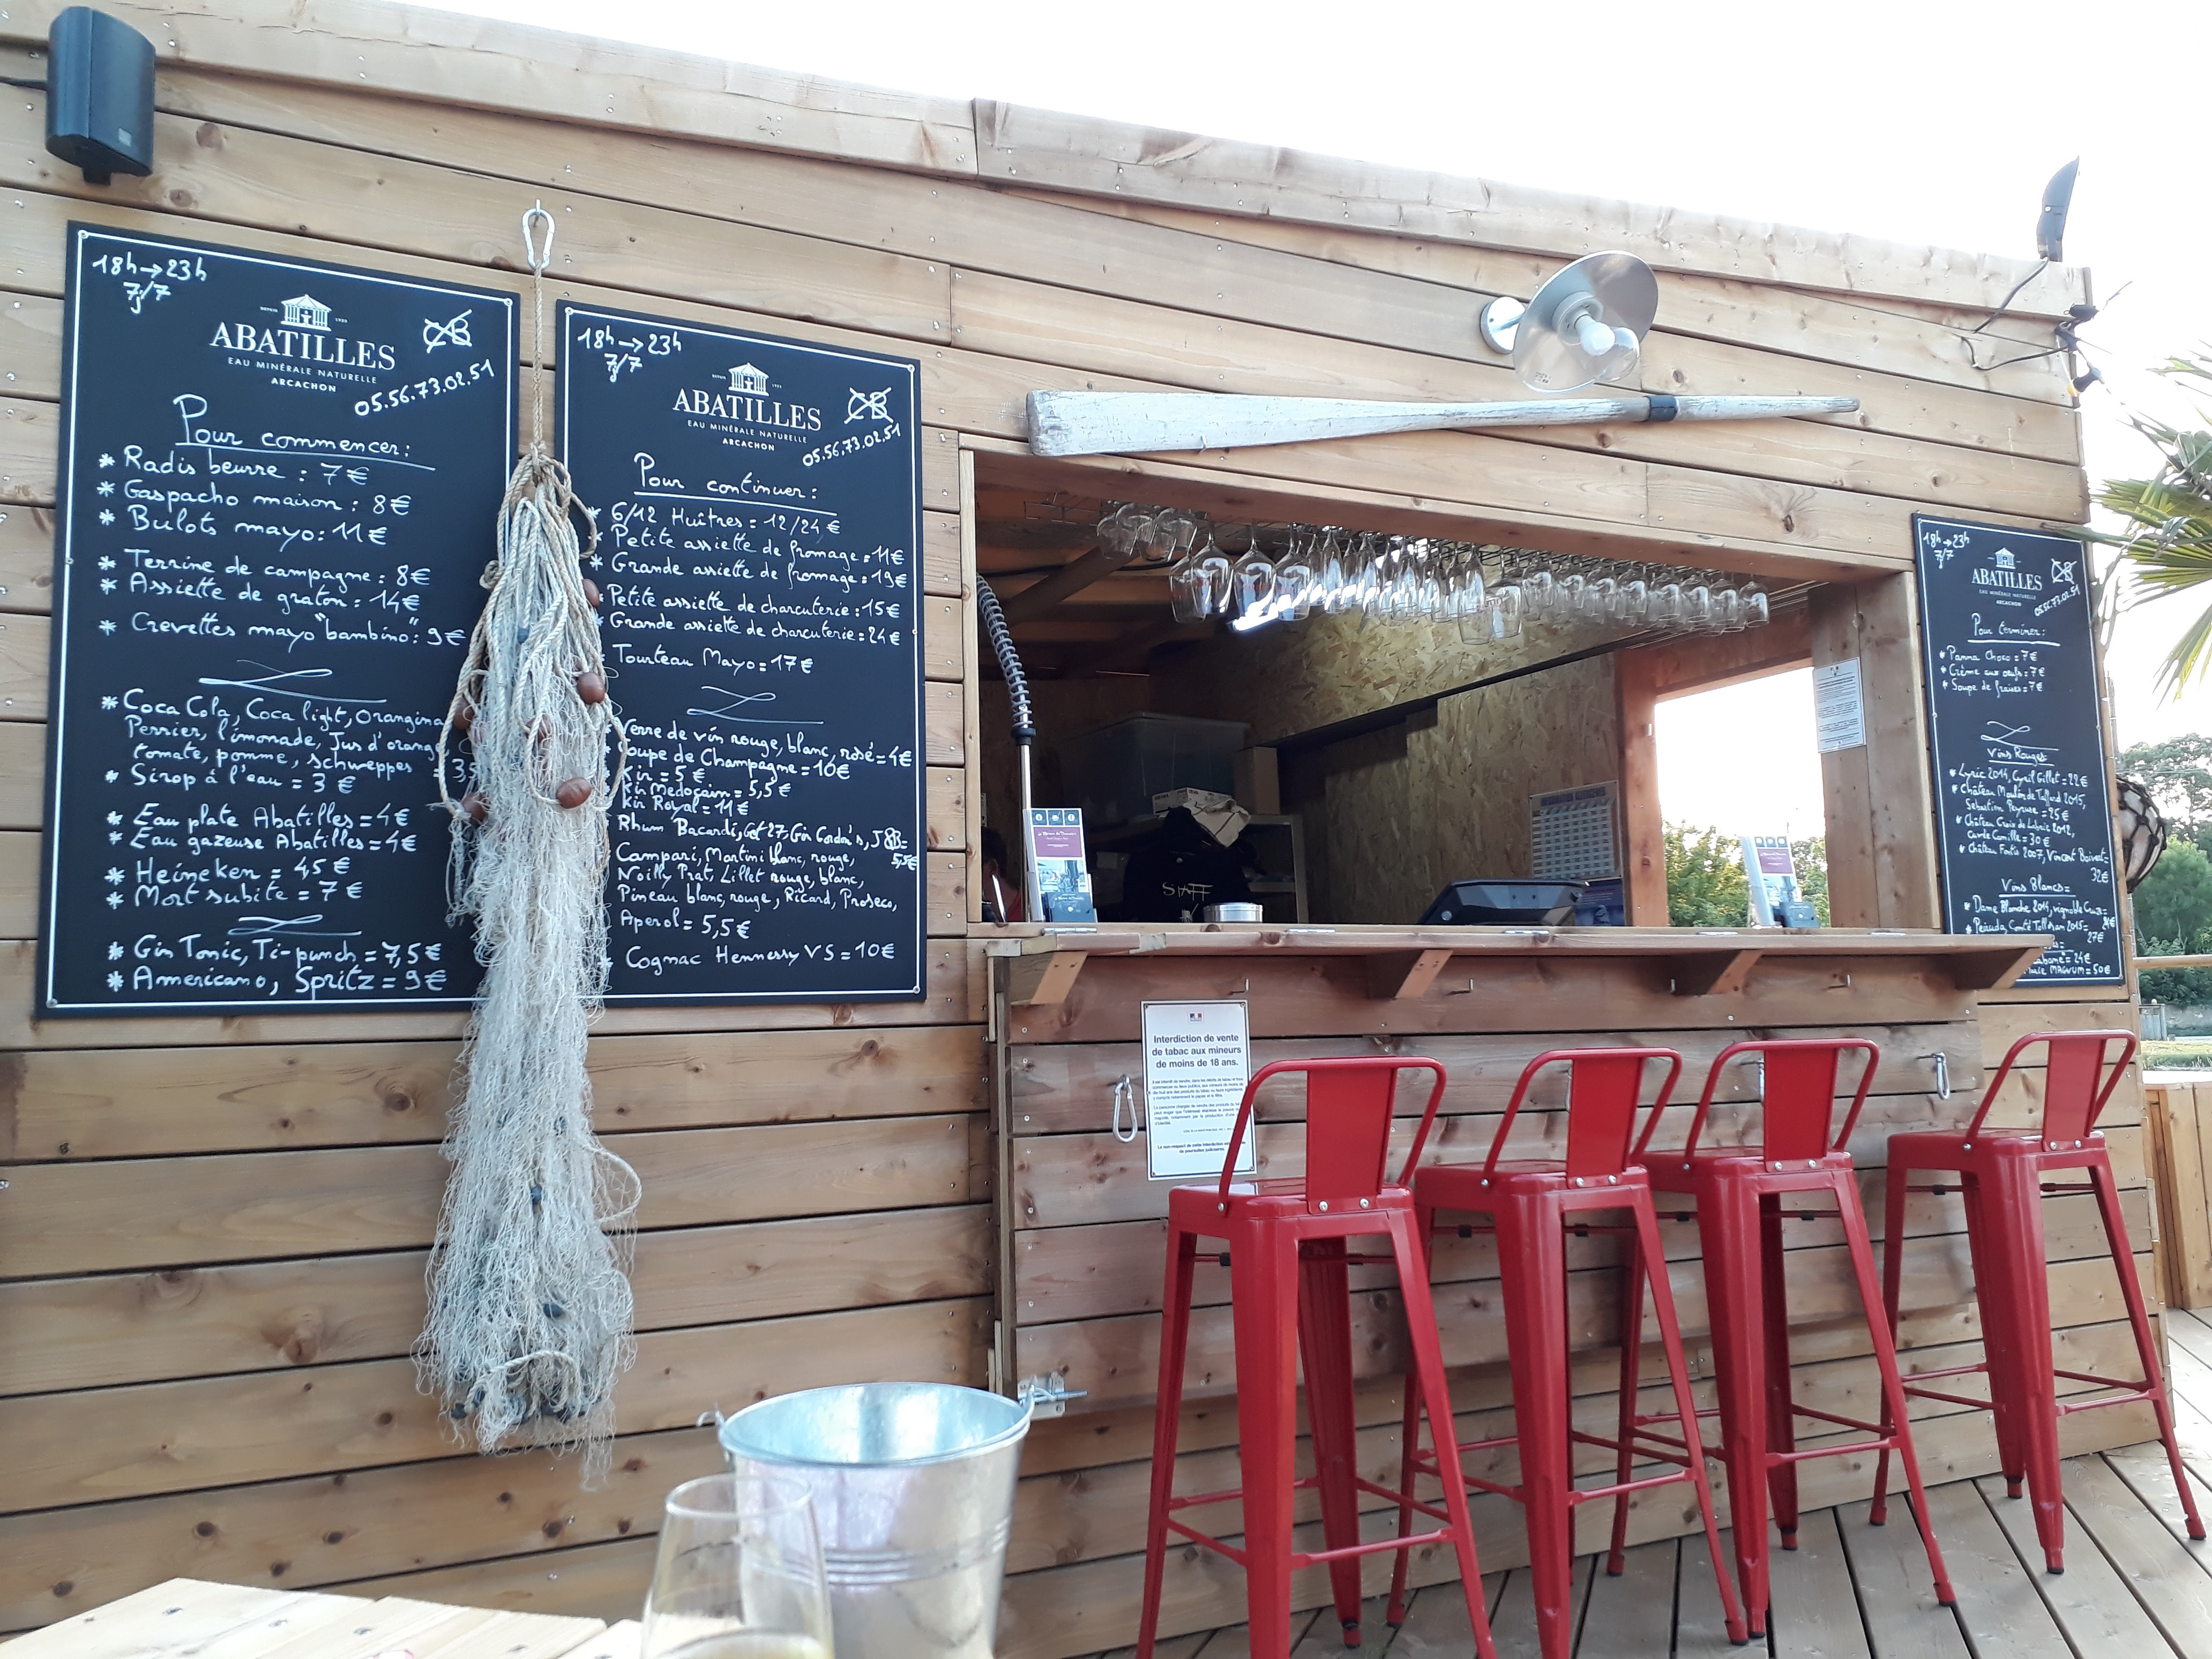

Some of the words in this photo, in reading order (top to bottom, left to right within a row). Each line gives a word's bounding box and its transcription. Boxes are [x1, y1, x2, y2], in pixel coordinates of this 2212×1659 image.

[210, 322, 397, 371] ABATILLES
[228, 356, 251, 368] EAU
[256, 361, 312, 377] MINÉRALE
[317, 368, 377, 385] NATURELLE
[271, 377, 337, 393] ARCACHON
[354, 358, 496, 417] 05.56.73.02.51
[173, 393, 244, 446] Pour
[672, 387, 823, 432] ABATILLES
[687, 419, 707, 429] EAU
[709, 422, 757, 437] MINÉRALE
[759, 428, 808, 444] NATURELLE
[722, 437, 776, 452] ARCACHON
[802, 422, 902, 467] 05.56.73.02.51
[124, 445, 197, 477] Radis
[208, 447, 287, 480] beurre
[633, 451, 686, 488] Pour
[124, 479, 239, 514] Gaspacho
[253, 492, 343, 512] maison
[372, 494, 412, 516] 8€
[127, 504, 217, 536] Bulots
[332, 521, 387, 545] 11€
[610, 500, 658, 526] 6/12
[671, 506, 744, 529] Huîtres
[610, 522, 676, 549] Petite
[683, 533, 758, 554] assiette
[762, 540, 783, 558] de
[790, 539, 860, 572] fromage
[872, 544, 905, 565] 11€
[123, 548, 216, 574] Terrine
[225, 555, 253, 577] de
[263, 565, 372, 594] campagne
[395, 564, 431, 587] 8€
[610, 551, 688, 578] Grande
[693, 559, 756, 580] assiette
[760, 563, 779, 580] de
[788, 562, 858, 594] fromage
[870, 570, 908, 589] 19€
[1971, 568, 2043, 591] ABATILLES
[129, 571, 227, 601] Assiette
[237, 582, 263, 602] de
[277, 584, 348, 615] graton
[368, 588, 421, 612] 14€
[606, 584, 657, 608] Petite
[663, 589, 731, 612] assiette
[737, 593, 756, 614] de
[760, 594, 852, 618] charcuterie
[861, 599, 901, 619] 15€
[130, 611, 237, 637] Crevettes
[246, 625, 315, 654] mayo
[426, 626, 467, 647] 9€
[609, 611, 676, 632] Grande
[683, 615, 742, 636] assiette
[745, 618, 765, 638] de
[771, 619, 857, 642] charcuterie
[1971, 612, 1993, 636] Pour
[611, 642, 695, 667] Tourteau
[702, 648, 756, 674] Mayo
[769, 653, 814, 674] 17€
[1947, 644, 1981, 661] Panna
[1985, 650, 2011, 662] Choco
[1949, 663, 1981, 677] Crème
[1984, 669, 1999, 677] aux
[1951, 678, 1978, 697] Soupe
[1981, 679, 1992, 691] de
[123, 687, 182, 716] Coca
[245, 697, 296, 721] Coca
[124, 714, 208, 741] Perrier,
[328, 731, 362, 752] Jus
[693, 726, 724, 745] vin
[839, 741, 876, 764] rosé
[132, 742, 210, 764] tomate,
[700, 746, 798, 783] Champagne
[1986, 748, 2012, 759] Vins
[131, 762, 197, 791] Sirop
[229, 765, 283, 788] l'eau
[132, 802, 180, 827] Eau
[188, 803, 240, 834] plate
[253, 802, 354, 831] Abatilles
[376, 802, 410, 828] 4€
[652, 795, 698, 820] Royal
[617, 813, 664, 834] Rhum
[130, 826, 177, 849] Eau
[187, 833, 265, 857] gazeuse
[275, 828, 364, 853] Abatilles
[384, 829, 417, 854] 4€
[705, 847, 765, 863] Martini
[136, 856, 261, 885] Heineken
[617, 864, 673, 889] Noilly
[720, 865, 766, 885] Lillet
[2001, 878, 2027, 892] Vins
[134, 883, 199, 908] Mort
[205, 880, 289, 905] subite
[617, 887, 679, 904] Pineau
[620, 909, 681, 934] Aperol
[132, 933, 175, 960] Gin
[178, 932, 250, 966] Tonic,
[625, 945, 703, 976] Cognac
[715, 944, 800, 967] Hennessy
[855, 940, 896, 960] 10€
[294, 965, 376, 1000] Spritz
[403, 969, 447, 991] 9€
[1152, 1047, 1163, 1056] de
[1164, 1046, 1189, 1056] tabac
[1208, 1045, 1242, 1055] mineurs
[1153, 1034, 1202, 1044] Interdiction
[1204, 1034, 1215, 1042] de
[1216, 1033, 1239, 1042] vente
[1155, 1059, 1167, 1068] de
[1169, 1058, 1195, 1068] moins
[1197, 1058, 1208, 1067] de
[1209, 1058, 1220, 1067] 18
[1221, 1058, 1239, 1067] ans.
